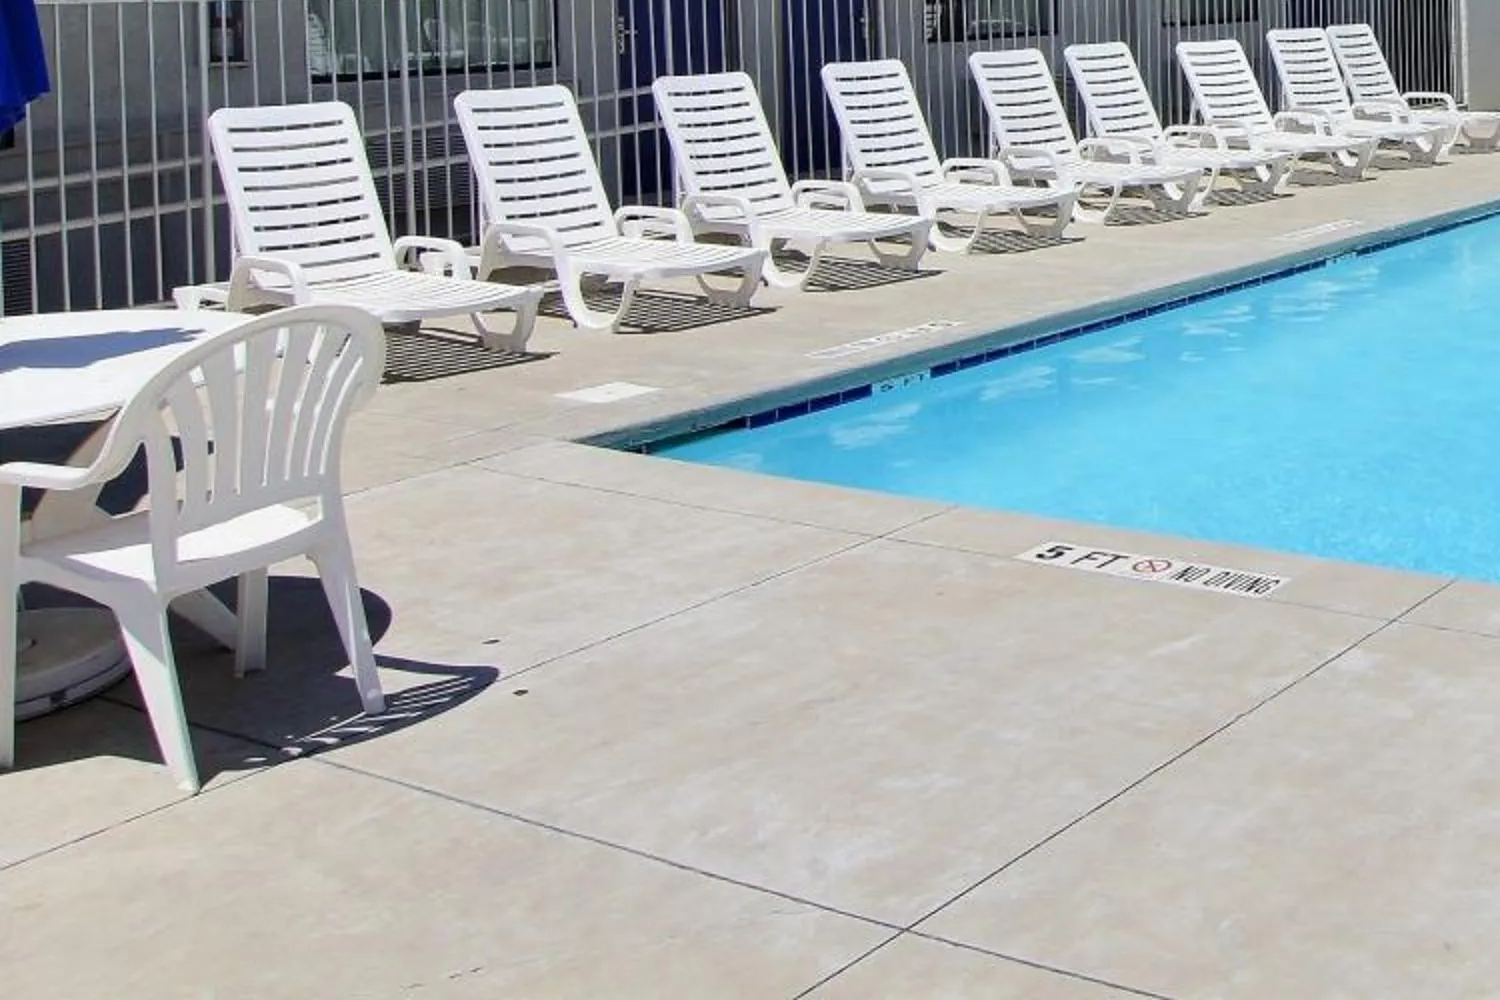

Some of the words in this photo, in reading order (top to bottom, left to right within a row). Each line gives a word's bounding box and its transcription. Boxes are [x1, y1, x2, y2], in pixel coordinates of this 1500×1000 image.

[1036, 545, 1073, 560] 5
[1070, 551, 1130, 569] FT
[1171, 565, 1211, 583] NO
[1203, 571, 1281, 595] DIVING
